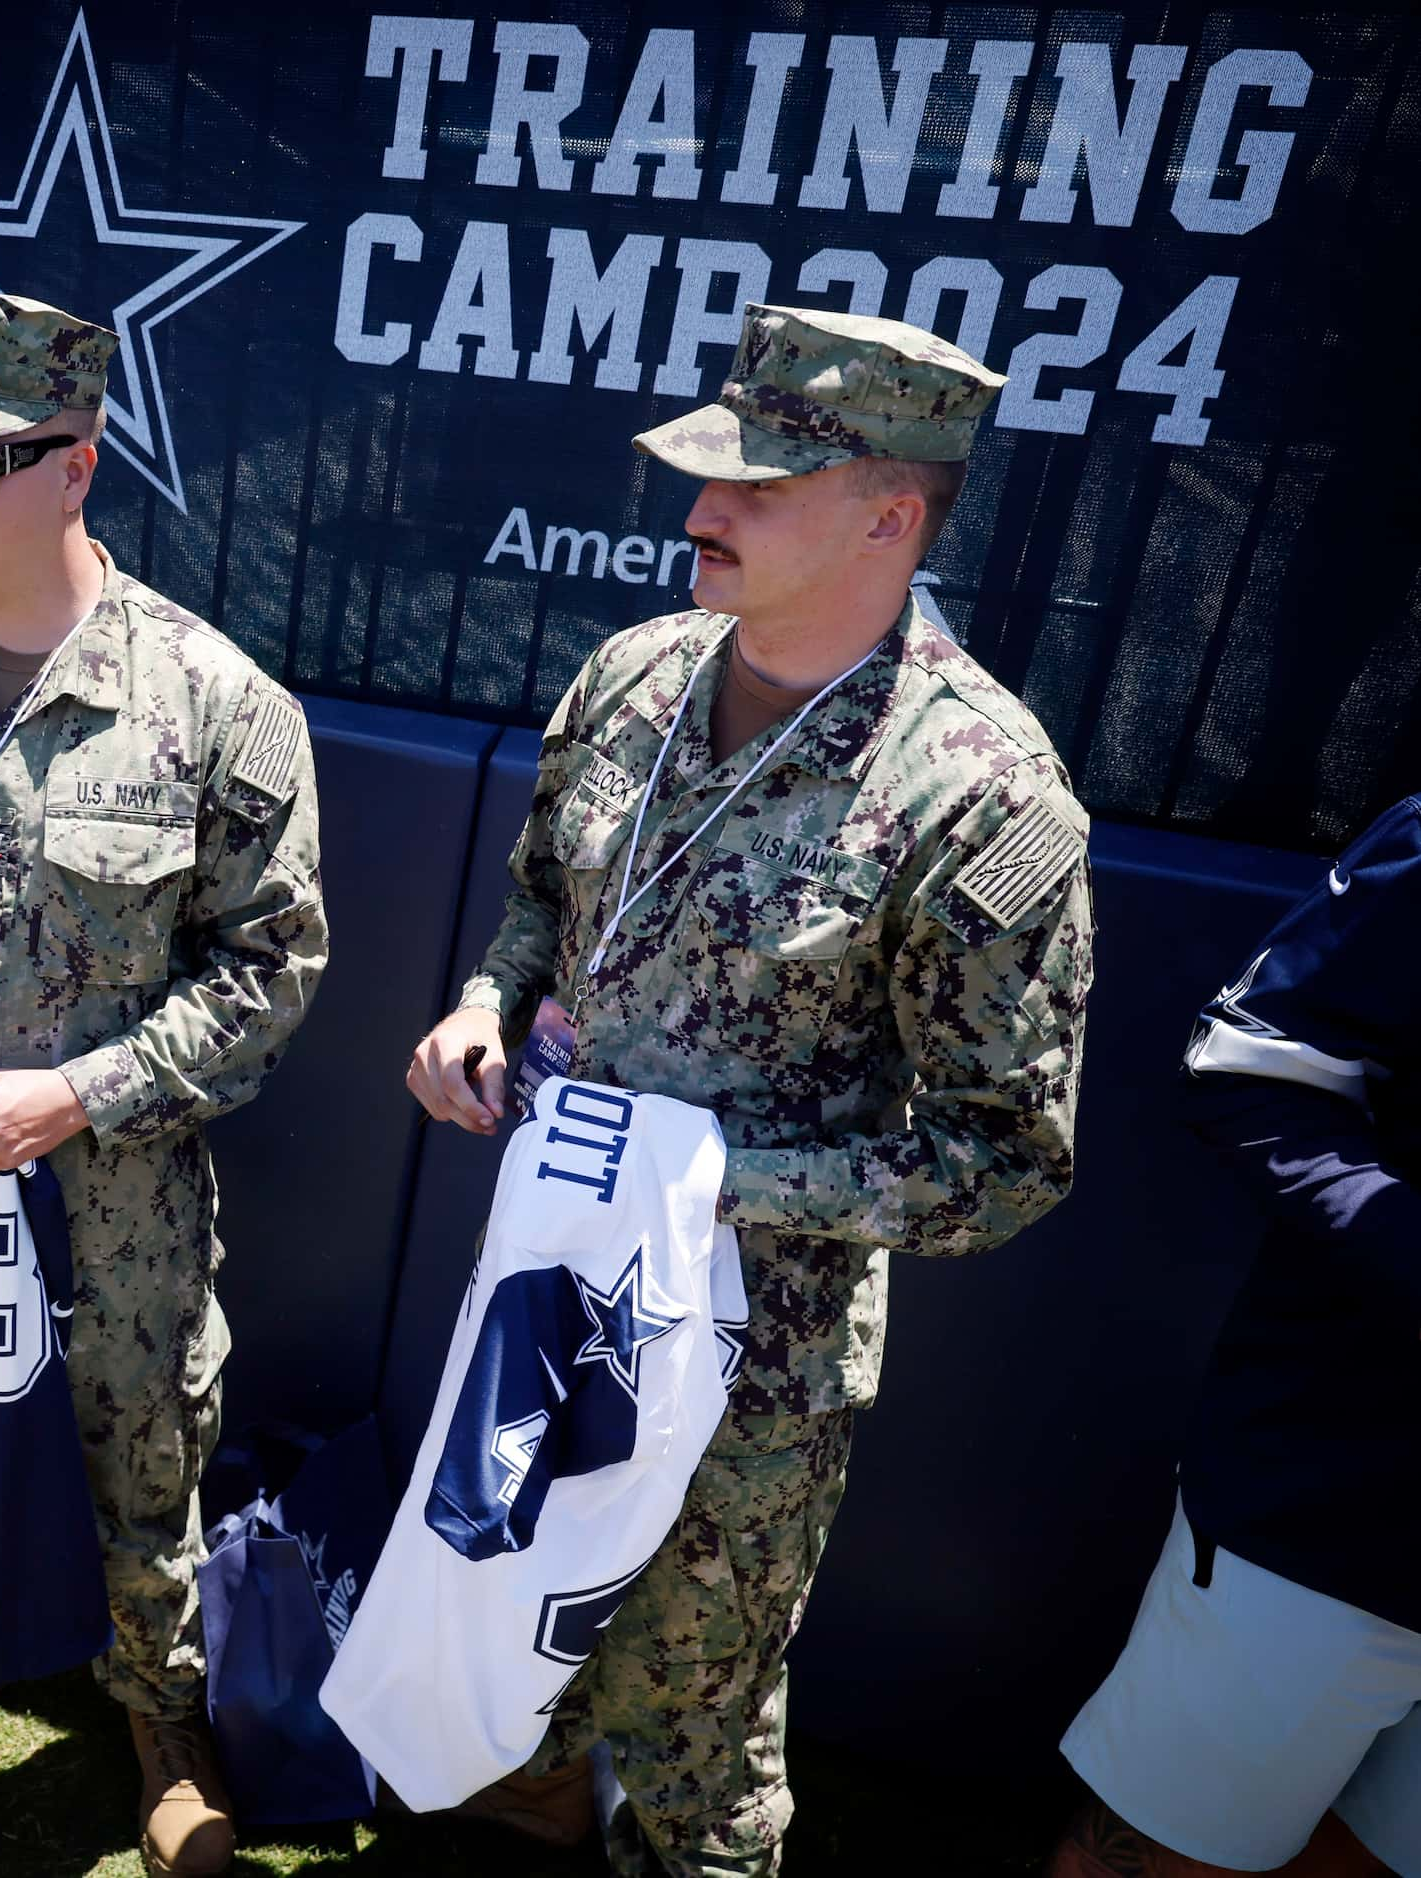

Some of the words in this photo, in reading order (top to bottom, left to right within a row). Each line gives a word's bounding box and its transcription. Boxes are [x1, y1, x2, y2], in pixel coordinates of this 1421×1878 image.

[365, 15, 1314, 235] TRAINING
[77, 781, 106, 805] U.S.
[115, 783, 161, 811] NAVY
[585, 758, 636, 804] LLOCK
[751, 831, 784, 862] U.S.
[788, 844, 850, 882] NAVY
[537, 1084, 633, 1204] OTT
[325, 1568, 357, 1653] AINING
